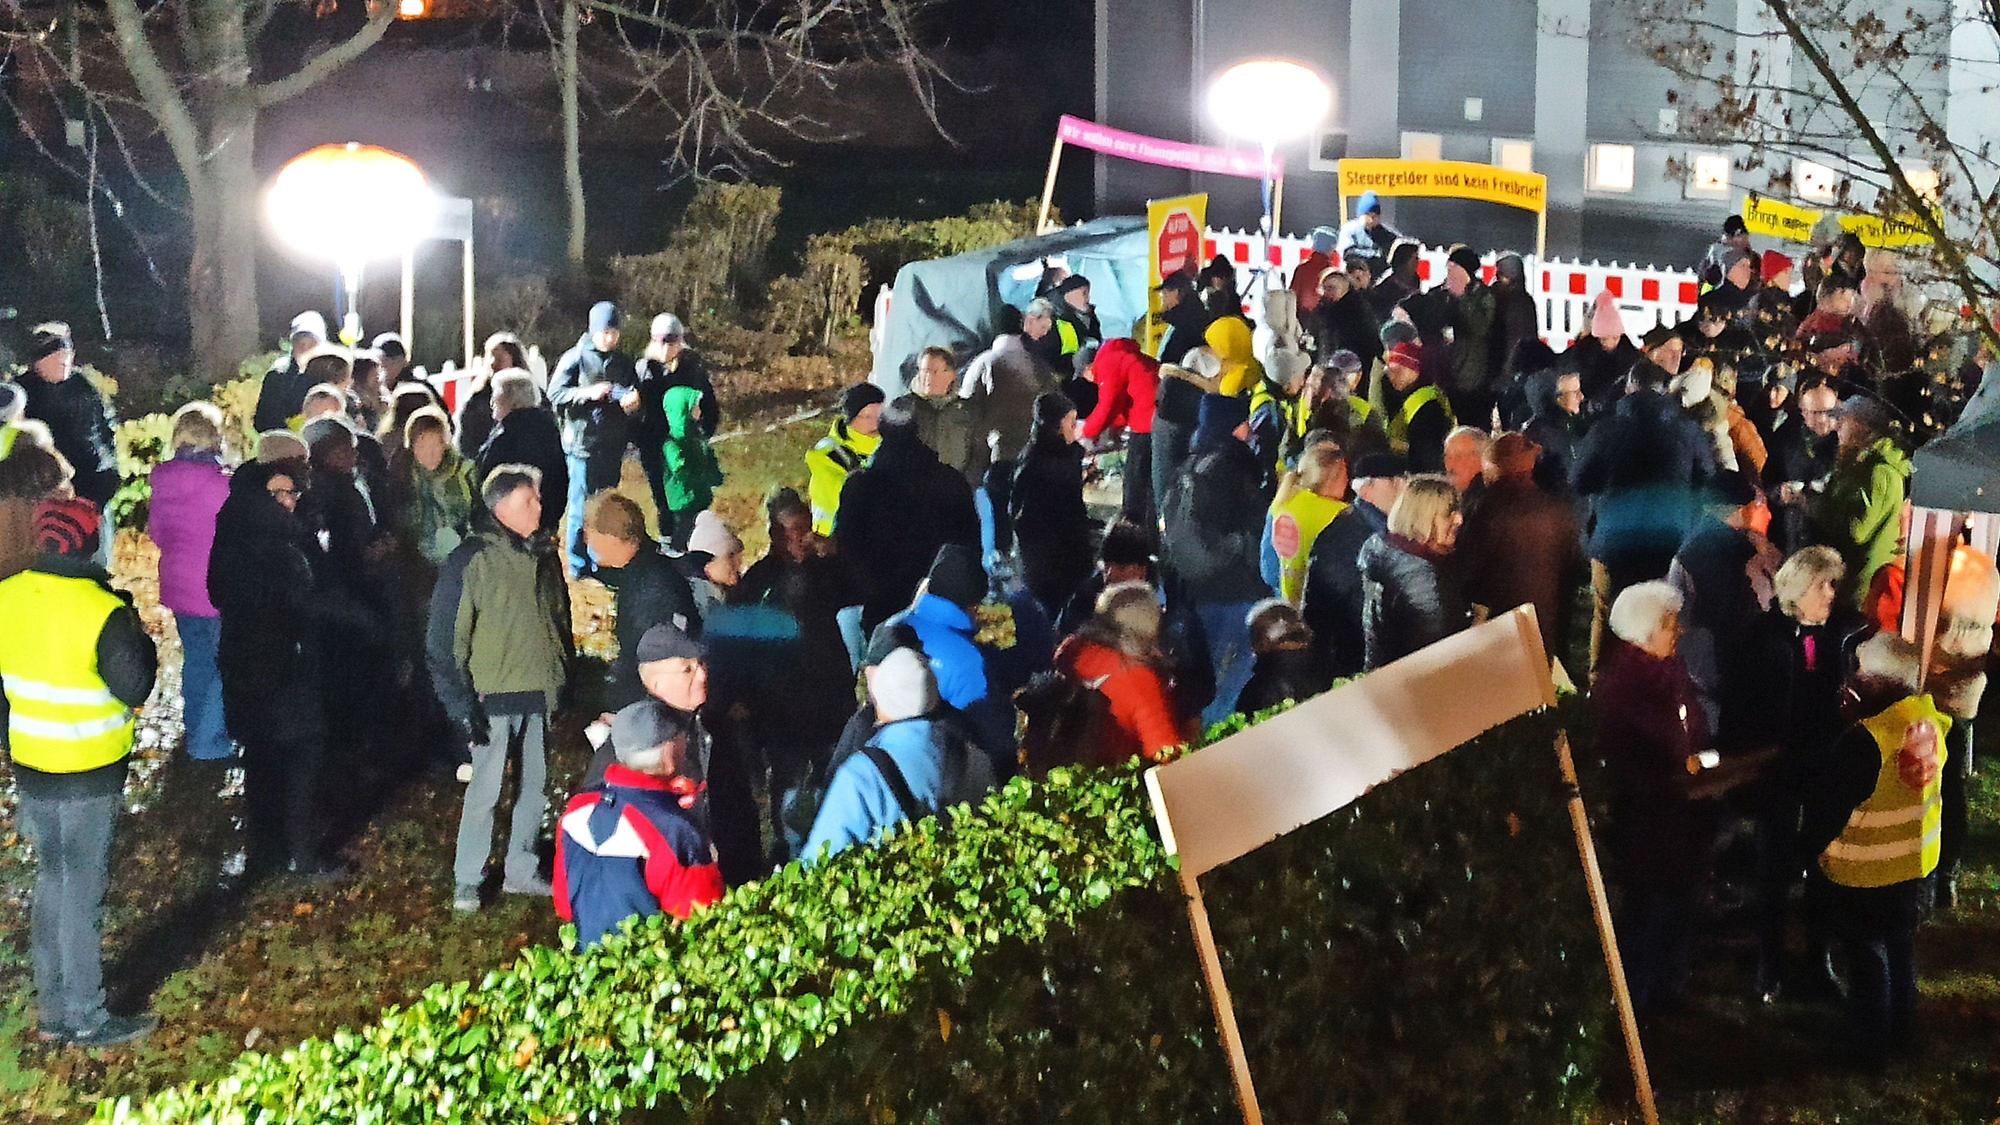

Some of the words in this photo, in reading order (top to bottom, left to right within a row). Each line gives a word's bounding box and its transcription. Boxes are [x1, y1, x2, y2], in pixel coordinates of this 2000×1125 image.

[1346, 171, 1427, 187] Steuergelder
[1433, 173, 1459, 186] sind
[1463, 173, 1489, 190] kein
